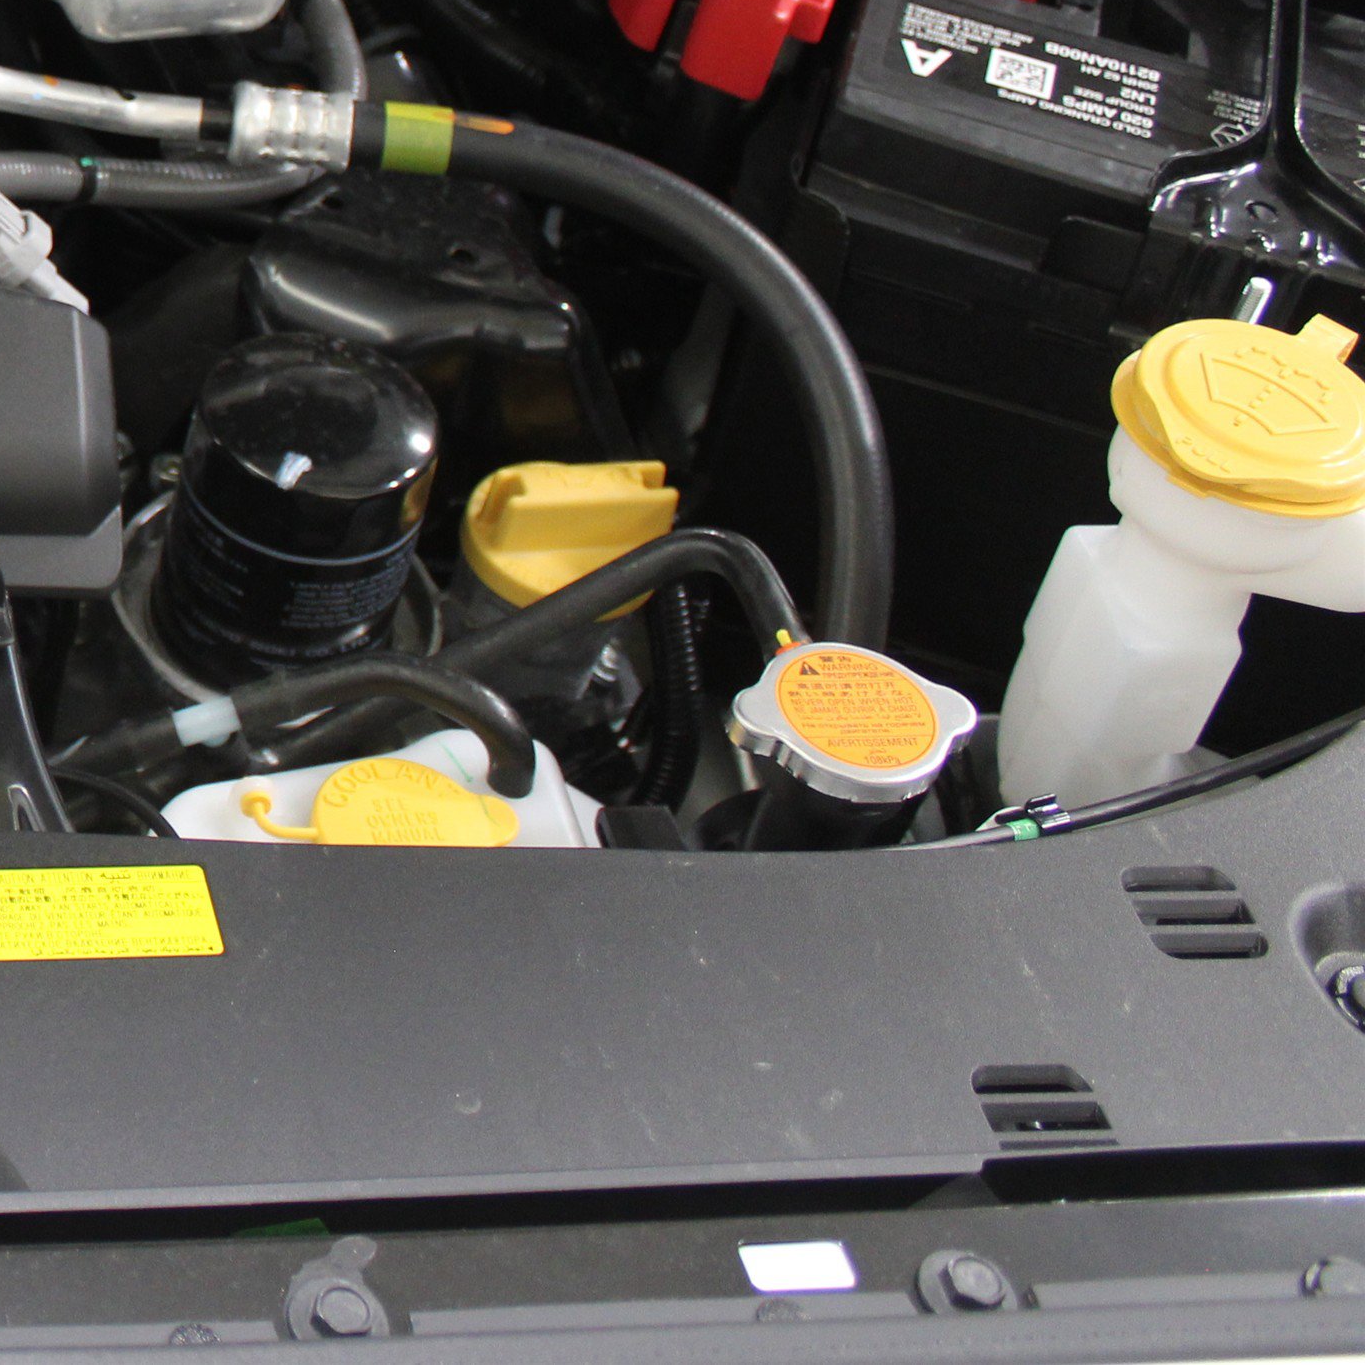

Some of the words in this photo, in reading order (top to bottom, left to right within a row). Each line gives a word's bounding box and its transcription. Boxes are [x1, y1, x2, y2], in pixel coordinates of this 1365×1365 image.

[1121, 74, 1160, 93] 20HR
[997, 88, 1038, 106] AMPS
[1073, 85, 1104, 102] SIZE
[1119, 86, 1157, 106] LN2
[1038, 100, 1111, 128] CRANKING
[1062, 95, 1118, 119] AMPS
[1104, 96, 1156, 116] GROUP
[1112, 120, 1152, 139] COLD
[1119, 111, 1154, 129] 620
[1175, 436, 1232, 474] PULL
[820, 663, 878, 671] WARNING
[827, 737, 918, 748] AVERTISSEMENT
[371, 827, 445, 844] MANUAL
